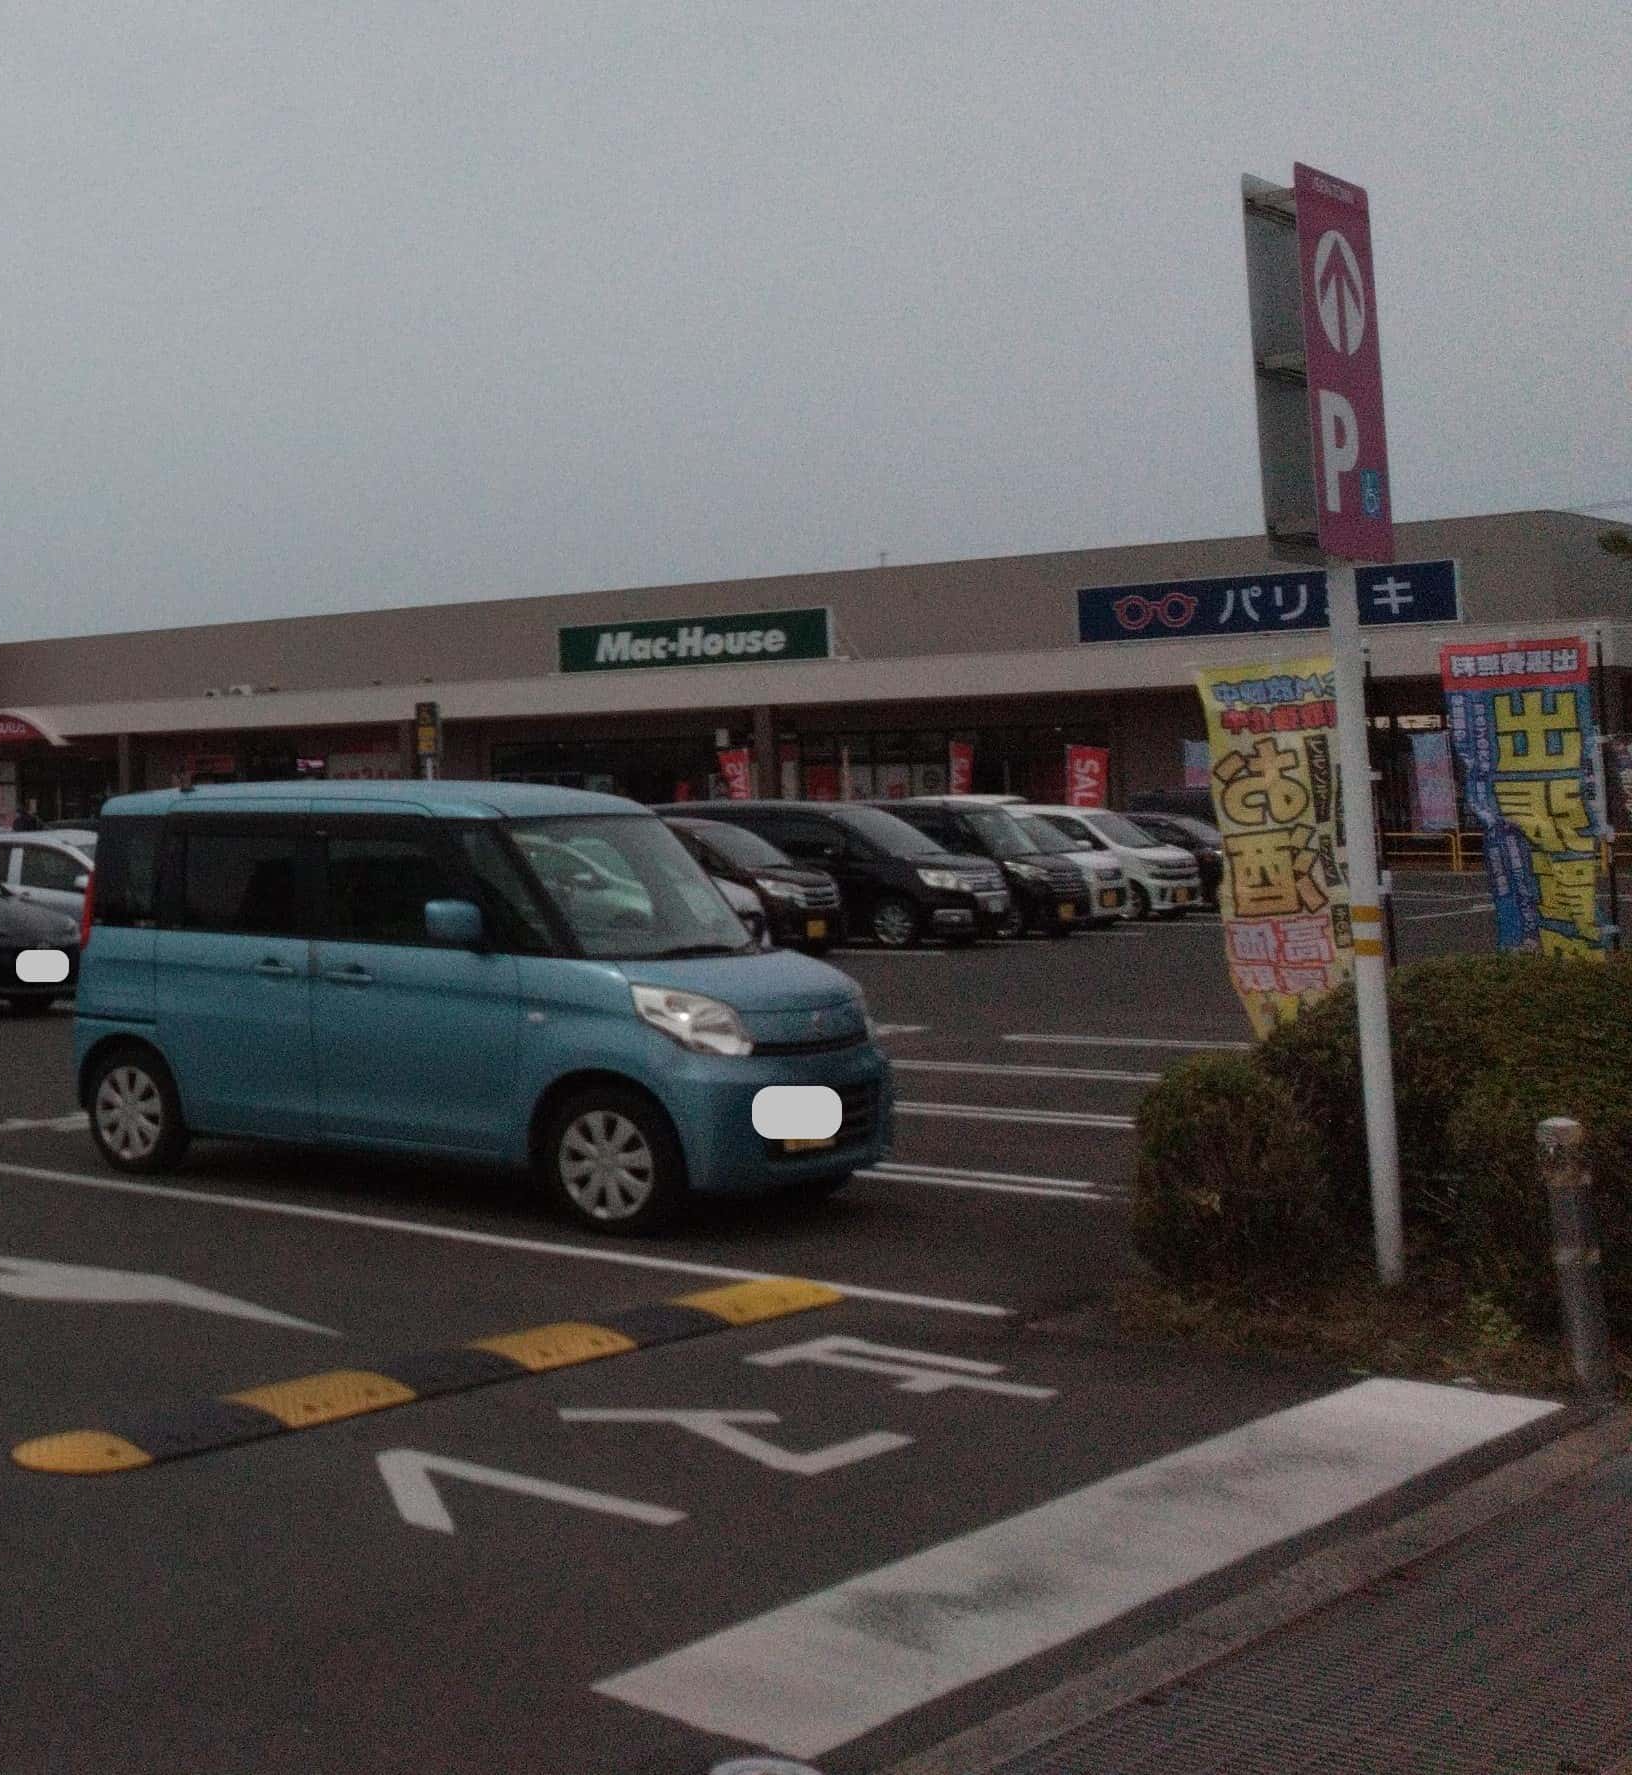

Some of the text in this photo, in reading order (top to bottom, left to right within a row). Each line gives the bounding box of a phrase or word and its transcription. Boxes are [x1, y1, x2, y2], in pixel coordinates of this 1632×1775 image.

[1318, 388, 1359, 513] P
[1218, 576, 1415, 624] パリキ
[595, 625, 787, 663] Mac-House
